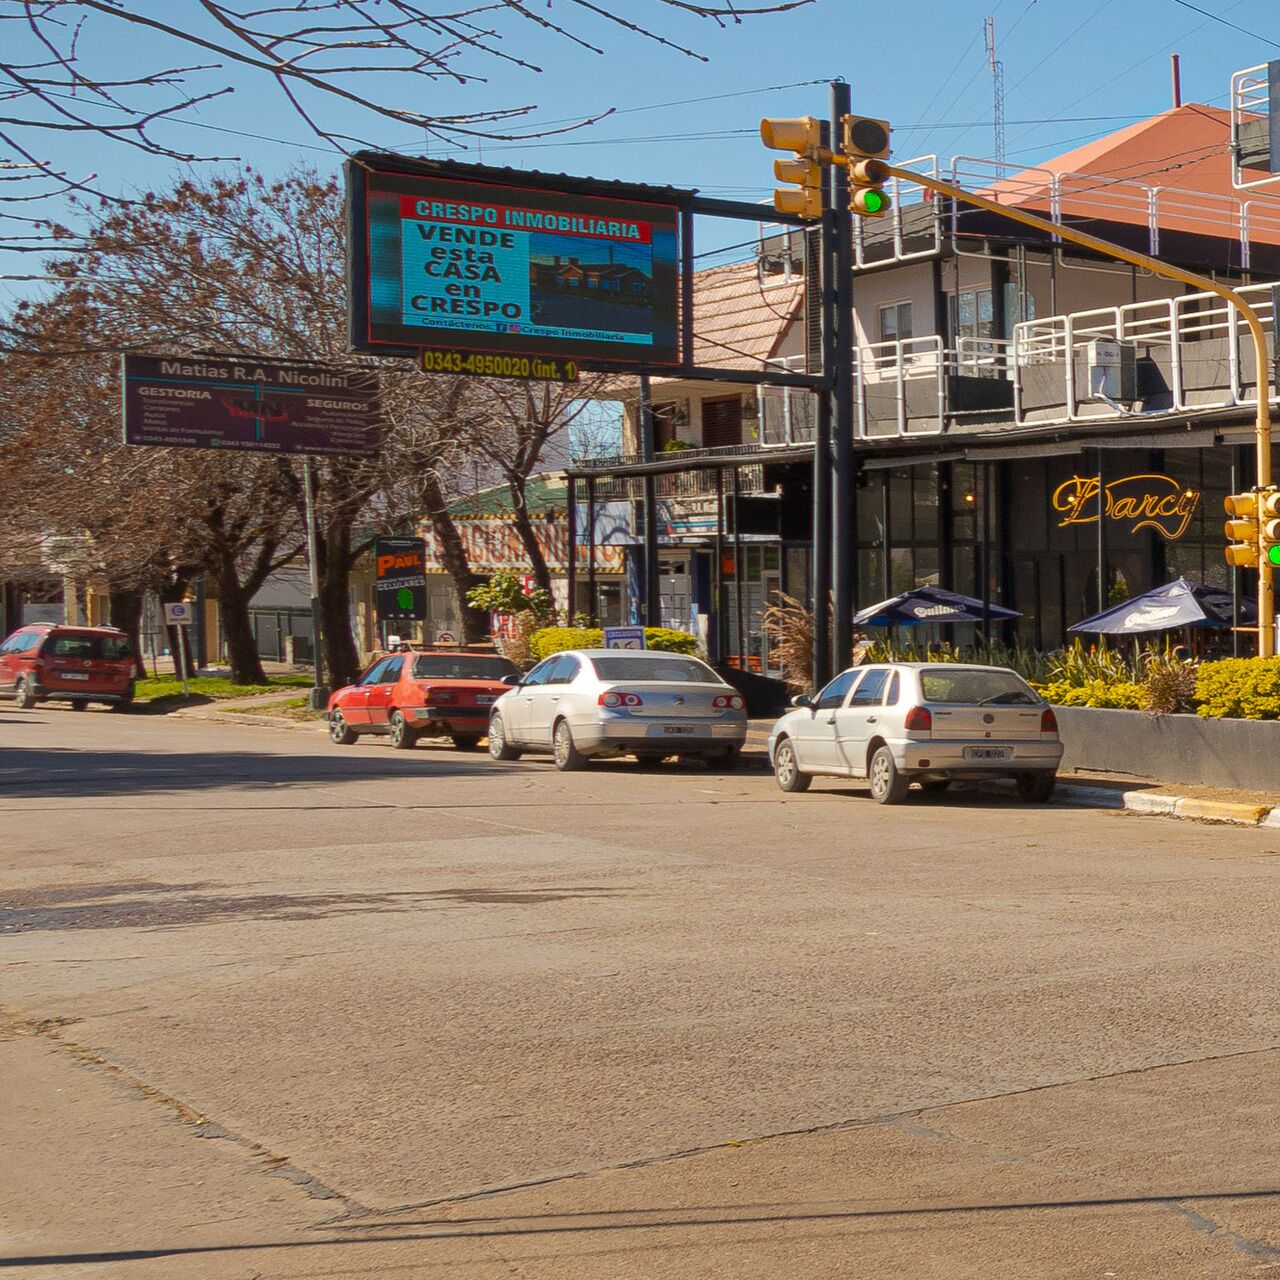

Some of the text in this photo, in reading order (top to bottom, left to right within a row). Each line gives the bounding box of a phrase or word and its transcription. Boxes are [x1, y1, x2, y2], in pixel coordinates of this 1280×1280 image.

[415, 200, 640, 239] CRESPO INMOBILIARIA
[416, 223, 515, 249] VENDE
[430, 246, 494, 265] esta
[424, 260, 501, 283] CASA
[444, 282, 481, 299] en
[411, 295, 522, 319] CRESPO
[522, 325, 559, 337] Crespo
[560, 328, 625, 342] Inmobiliaria
[160, 361, 348, 388] Matias R.A. Nicolini
[424, 351, 530, 377] 0343-4950020
[138, 386, 213, 400] GESTORIA
[306, 398, 369, 411] SEGUROS
[1052, 474, 1200, 540] Darcy
